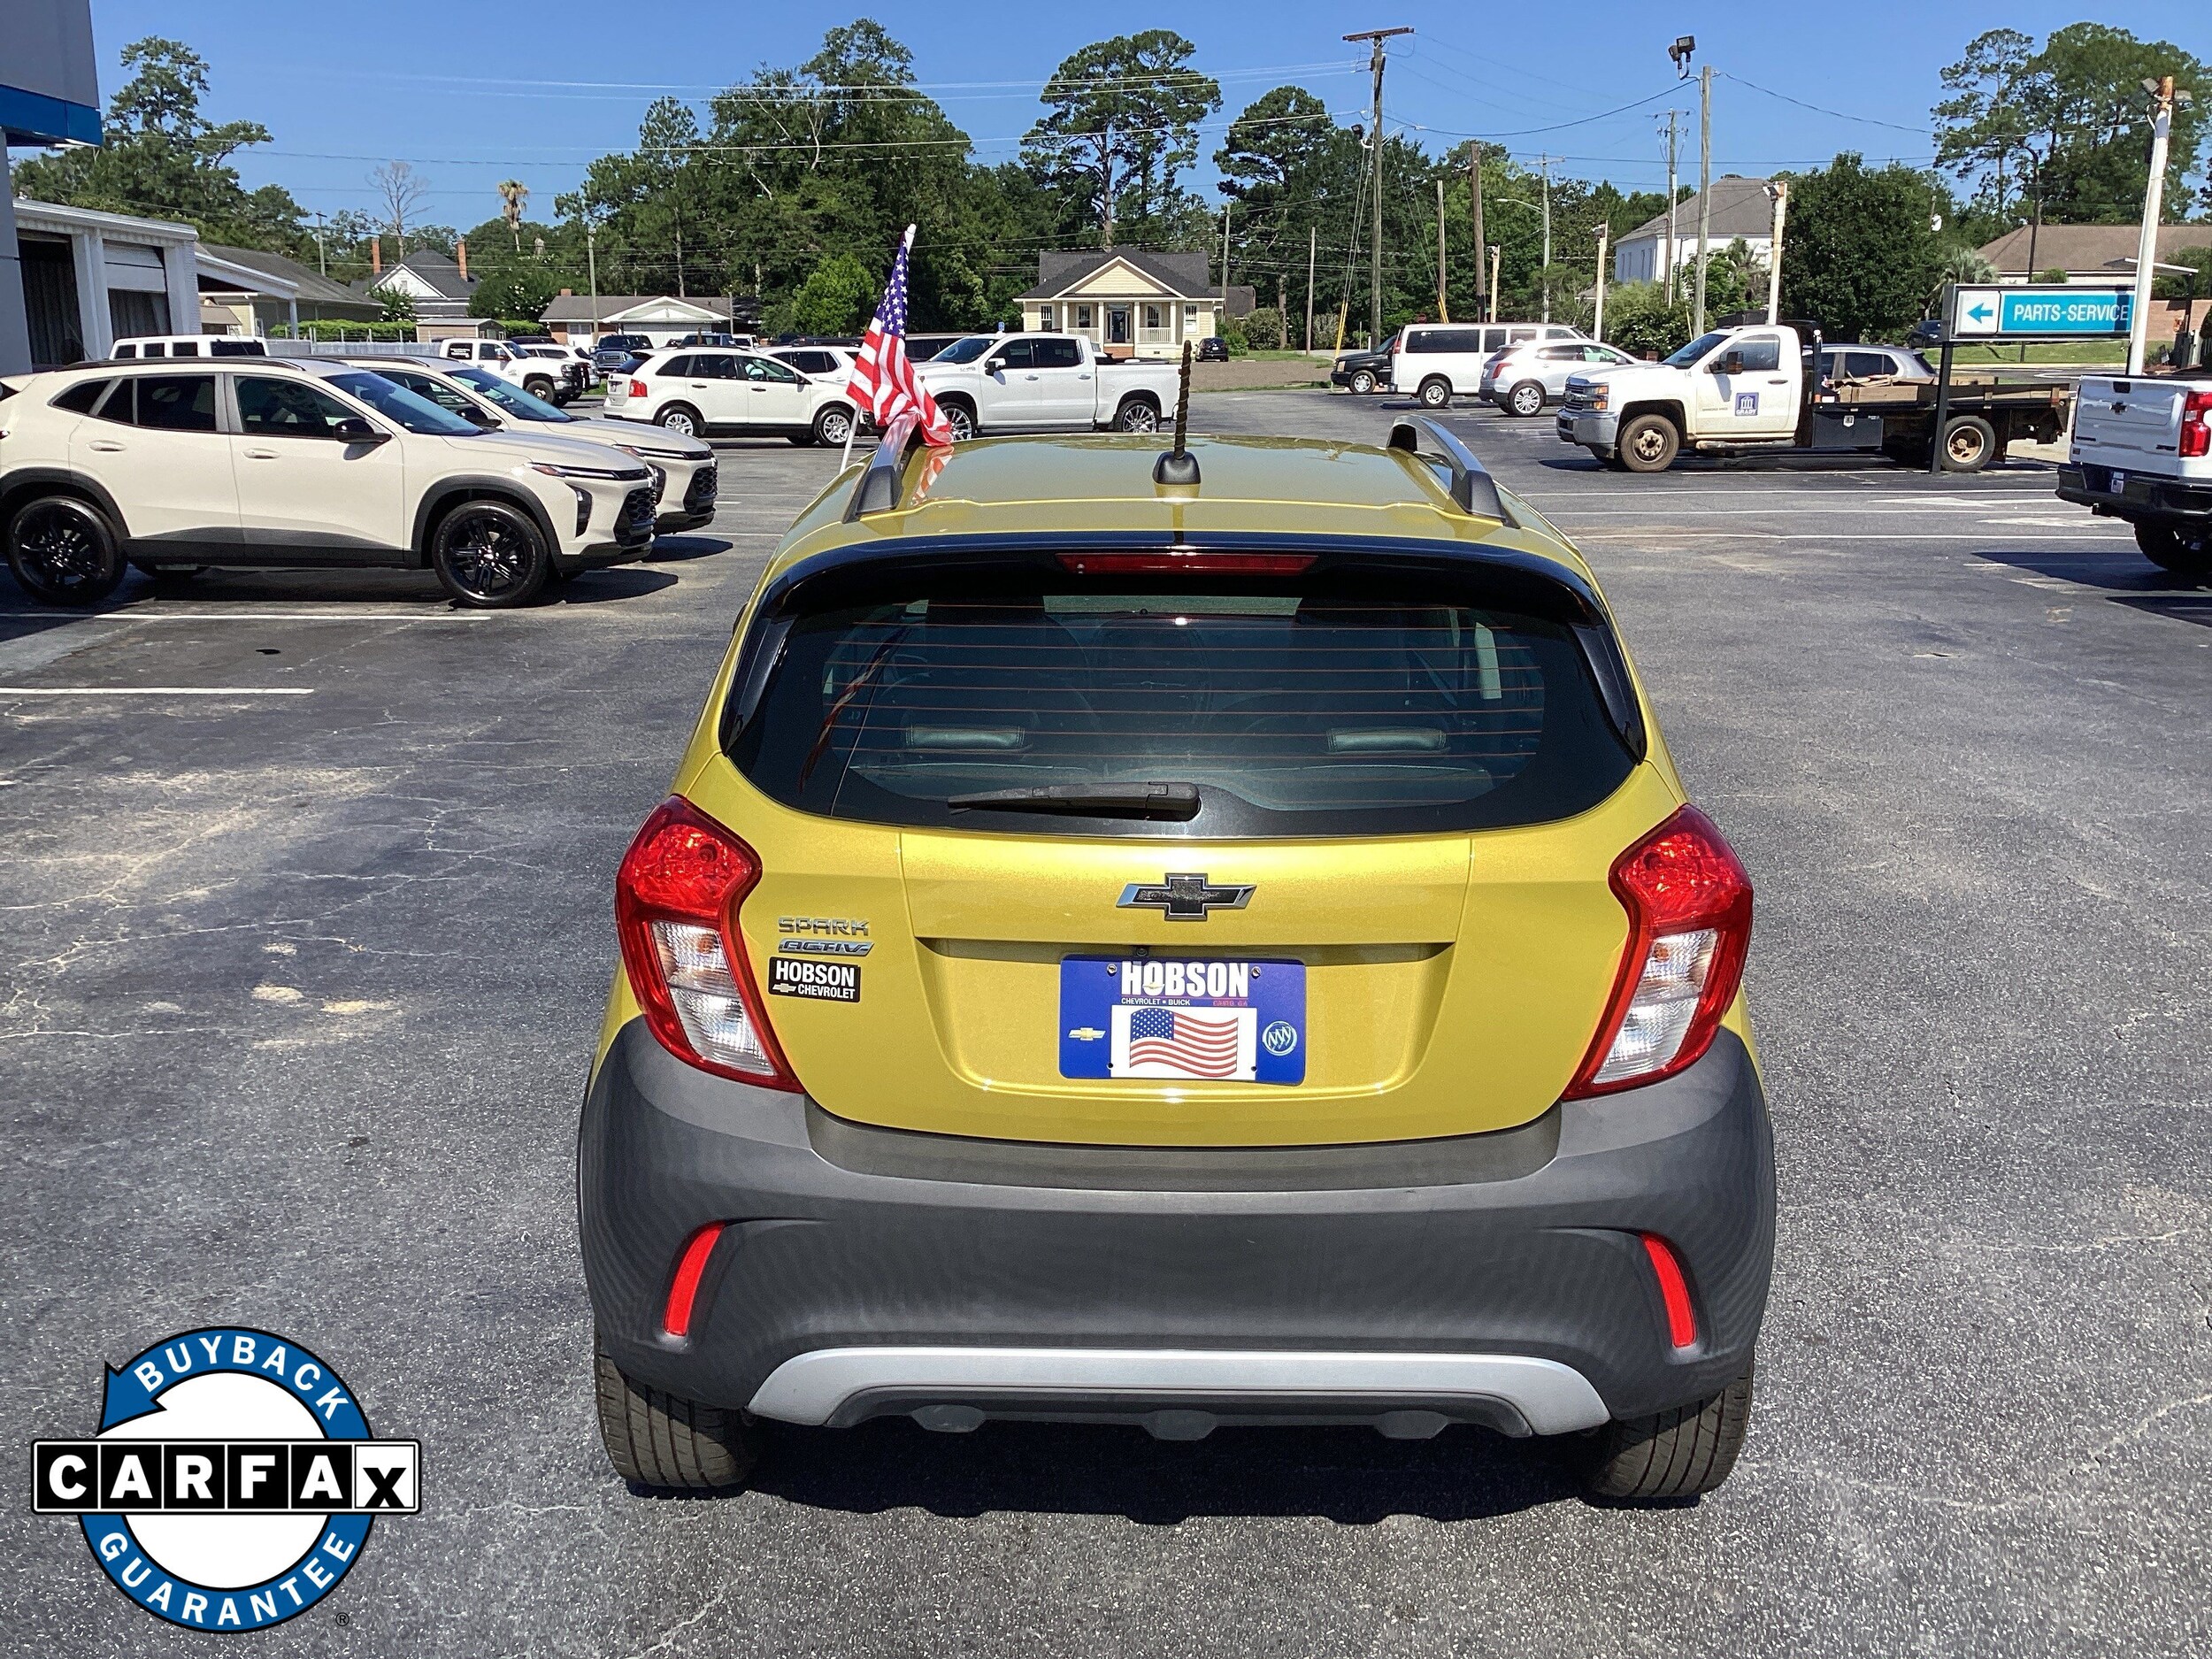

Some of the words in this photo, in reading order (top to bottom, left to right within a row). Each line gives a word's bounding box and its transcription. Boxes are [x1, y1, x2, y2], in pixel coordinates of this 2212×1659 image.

[2013, 303, 2130, 322] PARTS-SERVICE
[779, 917, 869, 936] SPARK
[783, 941, 869, 953] ACTIV
[775, 960, 855, 987] HOBSON
[1120, 960, 1248, 998] HOBSON
[797, 983, 856, 1000] CHEVROLET
[1120, 997, 1161, 1006] CHEVROLET
